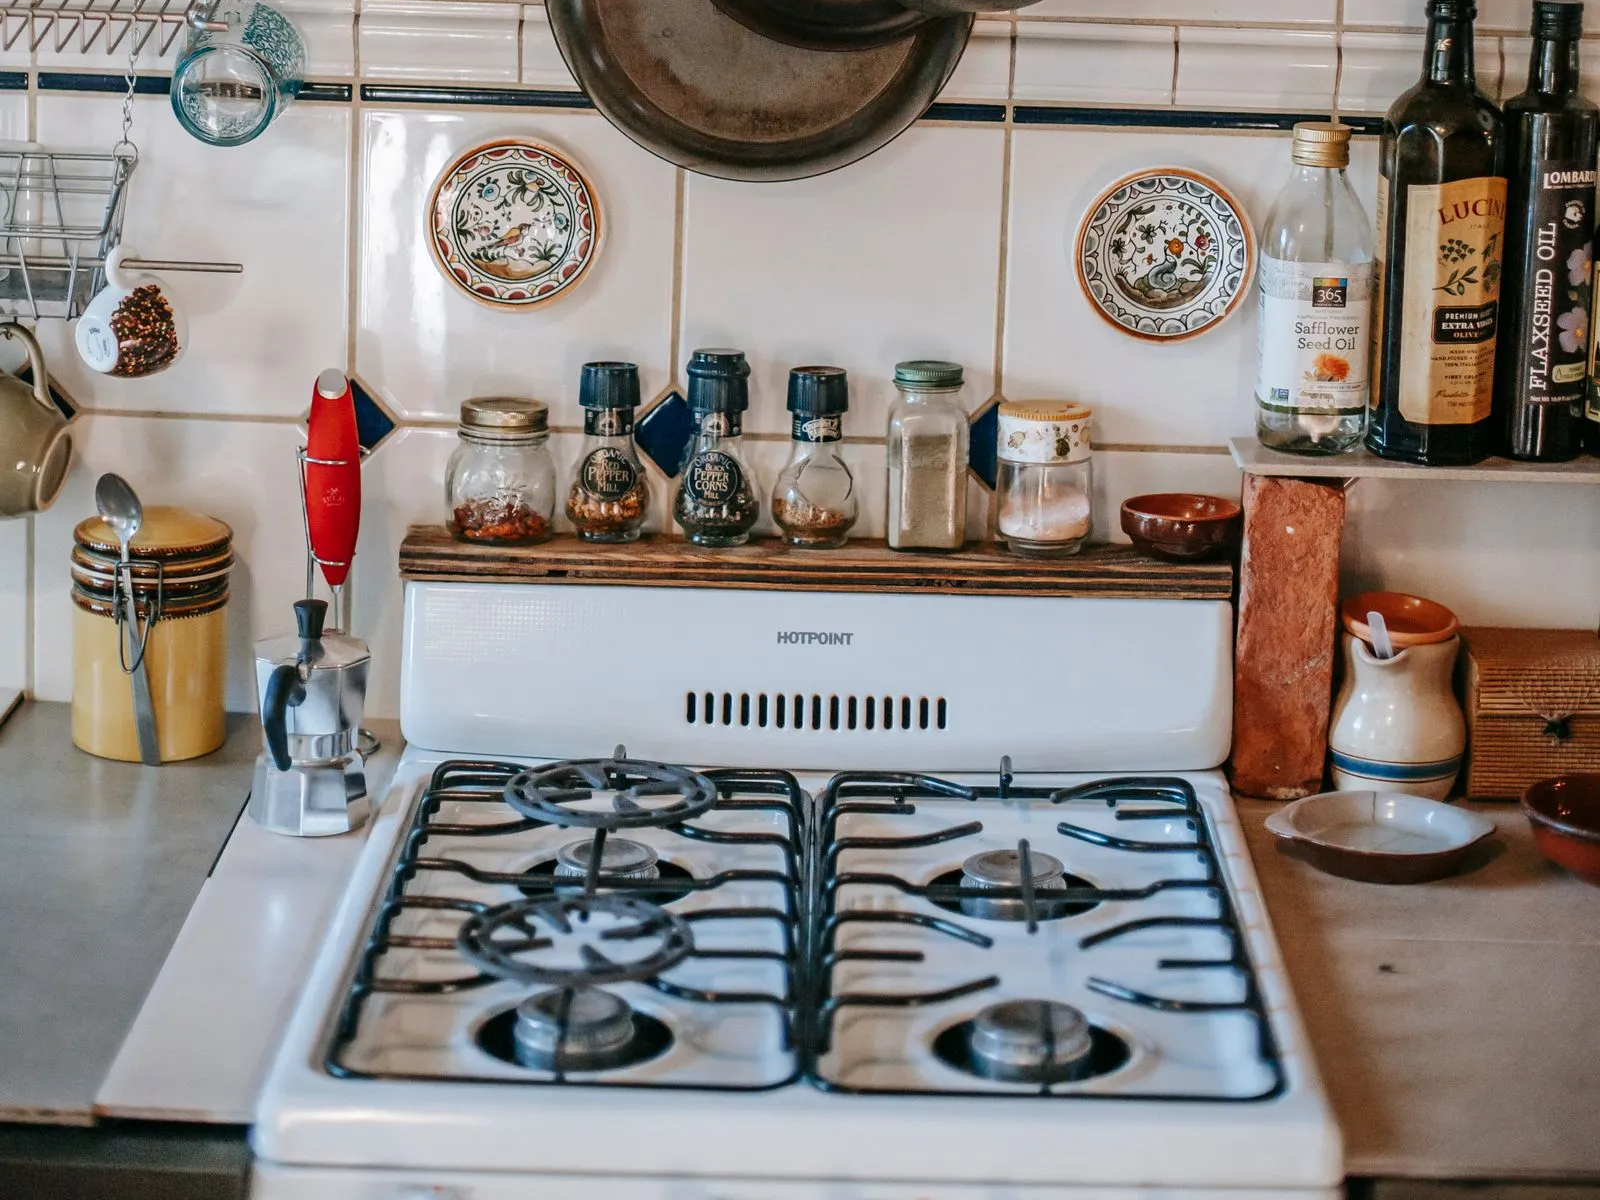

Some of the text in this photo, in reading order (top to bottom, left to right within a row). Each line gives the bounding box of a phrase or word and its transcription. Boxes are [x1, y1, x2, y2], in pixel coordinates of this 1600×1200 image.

[1529, 223, 1557, 390] FLAXSEED OIL
[1295, 322, 1360, 335] Safflower
[1441, 322, 1475, 330] EXTRA
[1298, 338, 1355, 350] Seed Oil
[694, 453, 733, 470] ORGANIC
[588, 466, 629, 482] PEPPER
[694, 467, 730, 482] PEPPER
[597, 481, 619, 492] MILL
[695, 480, 729, 492] CORNS
[777, 631, 854, 646] HOTPOINT
